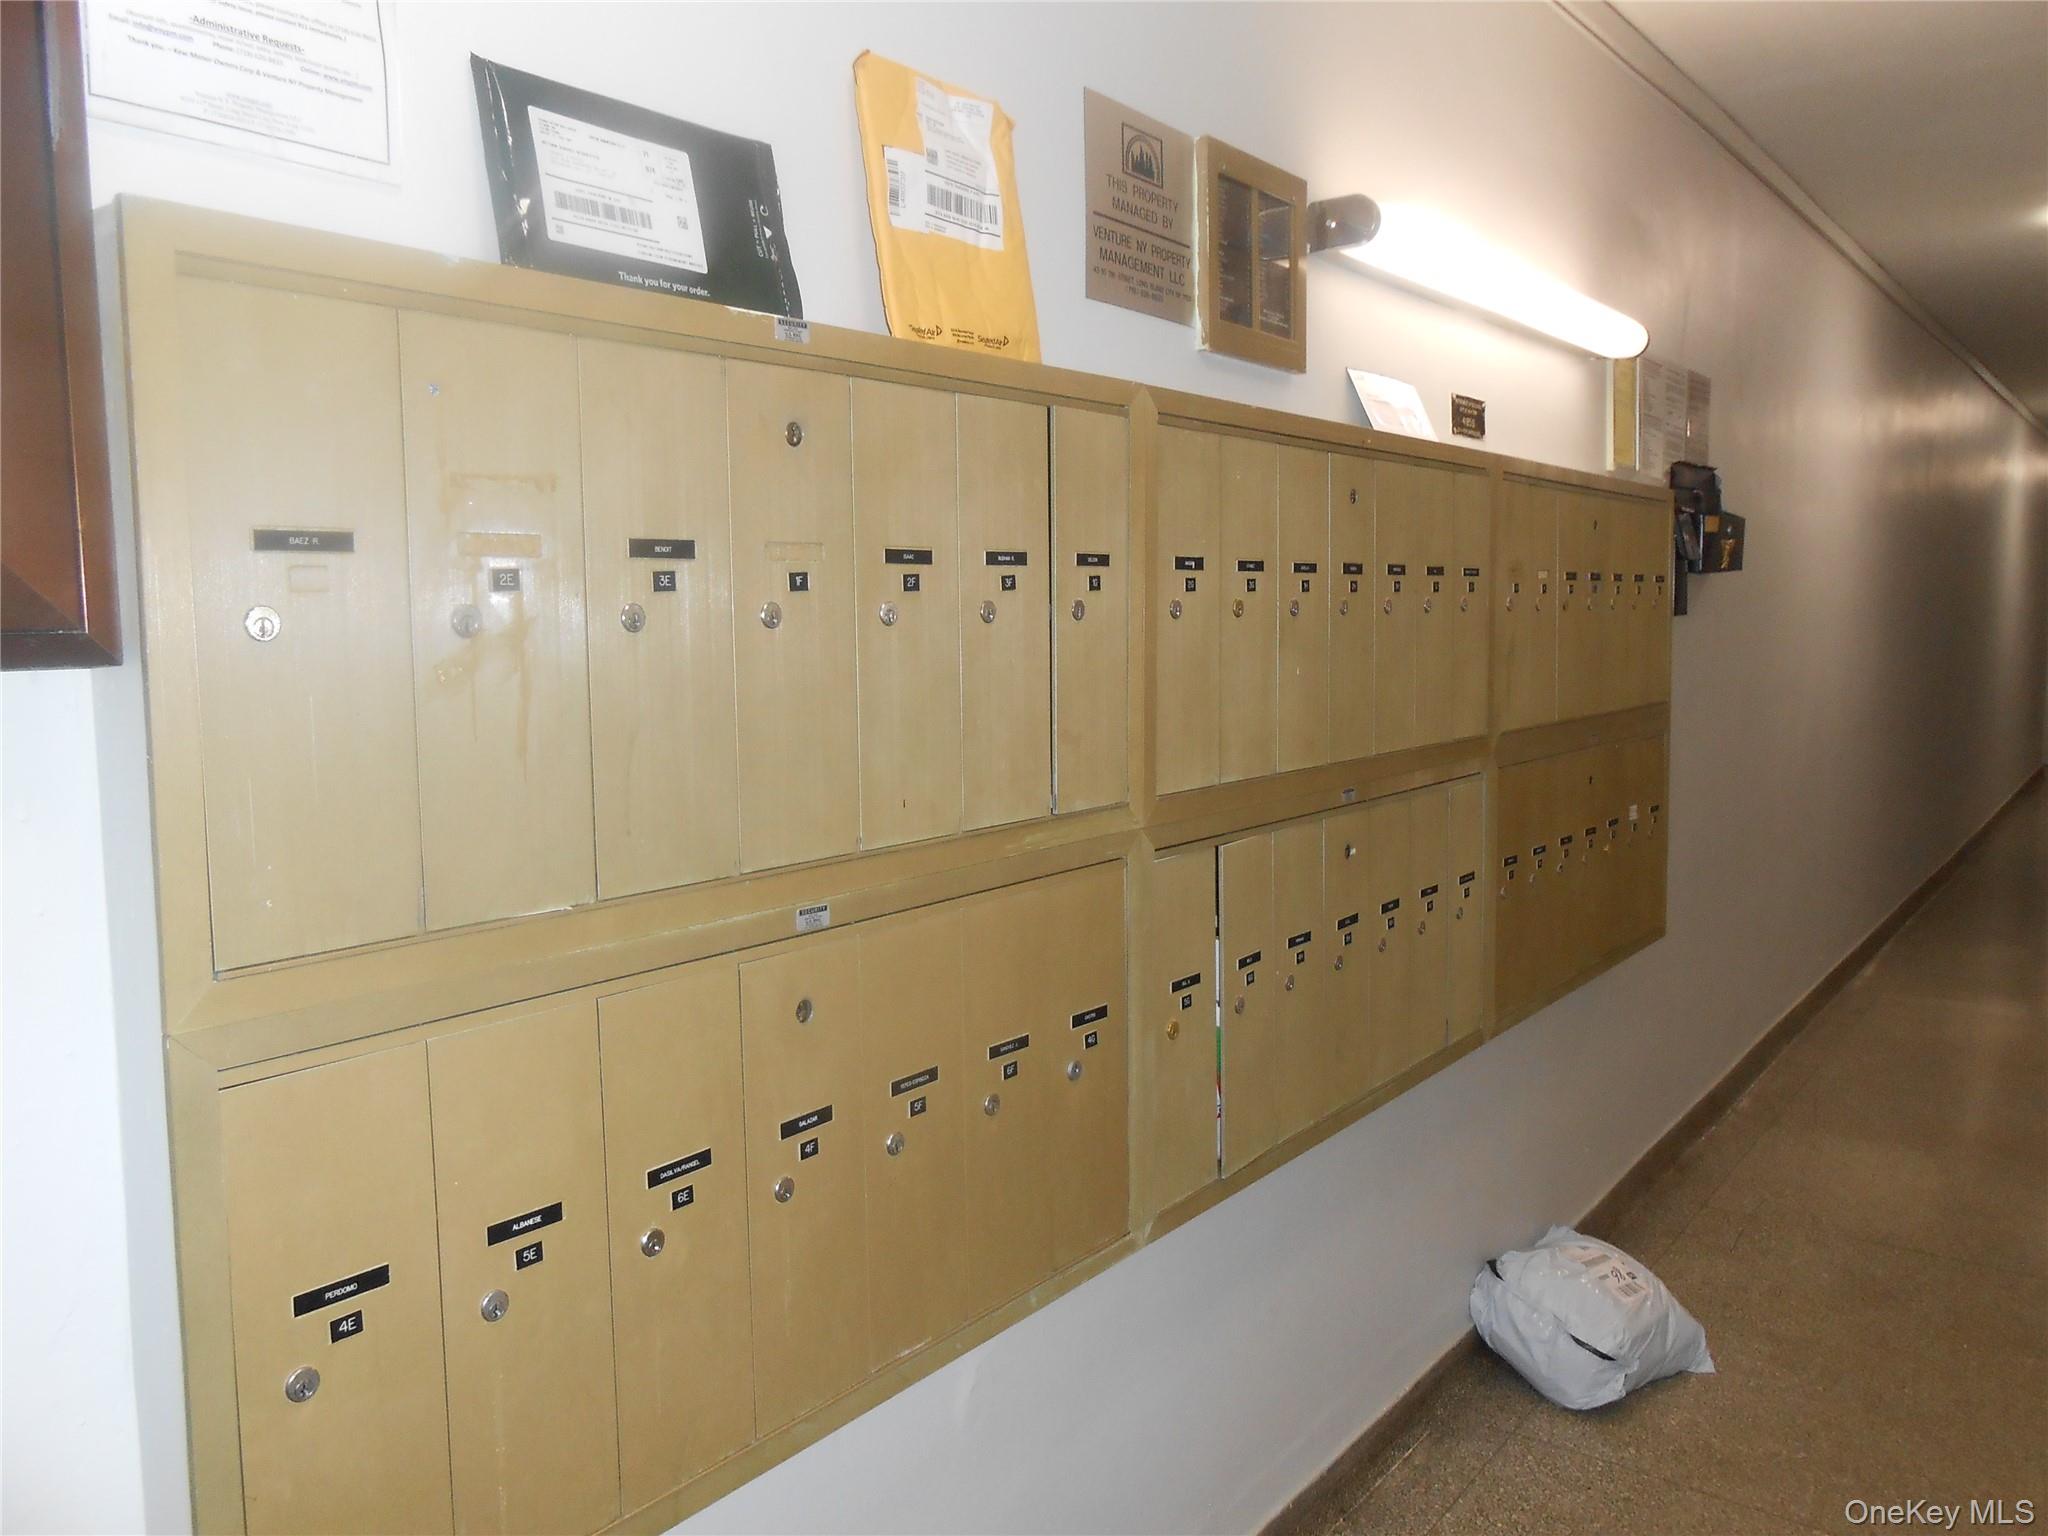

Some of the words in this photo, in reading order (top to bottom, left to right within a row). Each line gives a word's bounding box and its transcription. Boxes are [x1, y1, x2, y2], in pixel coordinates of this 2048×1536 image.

[1105, 172, 1128, 194] THIS
[1132, 183, 1179, 213] PROPERTY
[1111, 195, 1158, 225] MANAGED
[1162, 214, 1174, 231] BY
[1092, 223, 1132, 249] VENTURE
[1136, 239, 1148, 254] NY
[1150, 243, 1191, 270] PROPERTY
[1099, 246, 1165, 280] MANAGEMENT
[1168, 270, 1185, 287] LLC
[618, 271, 644, 285] Thank
[643, 278, 659, 288] you
[659, 278, 671, 290] for
[671, 282, 689, 293] your
[688, 286, 711, 298] order.
[499, 572, 515, 587] 2E
[658, 574, 672, 587] 3E
[795, 575, 803, 588] 1F
[906, 576, 917, 588] 2F
[1004, 577, 1013, 588] 3F
[1006, 1064, 1015, 1075] 6F
[914, 1100, 924, 1112] 5F
[804, 1141, 817, 1154] 4F
[677, 1190, 690, 1204] 6E
[511, 1214, 543, 1232] ALBANESE
[522, 1247, 538, 1263] 5E
[324, 1281, 358, 1301] PERDOMO
[338, 1316, 358, 1333] 4E
